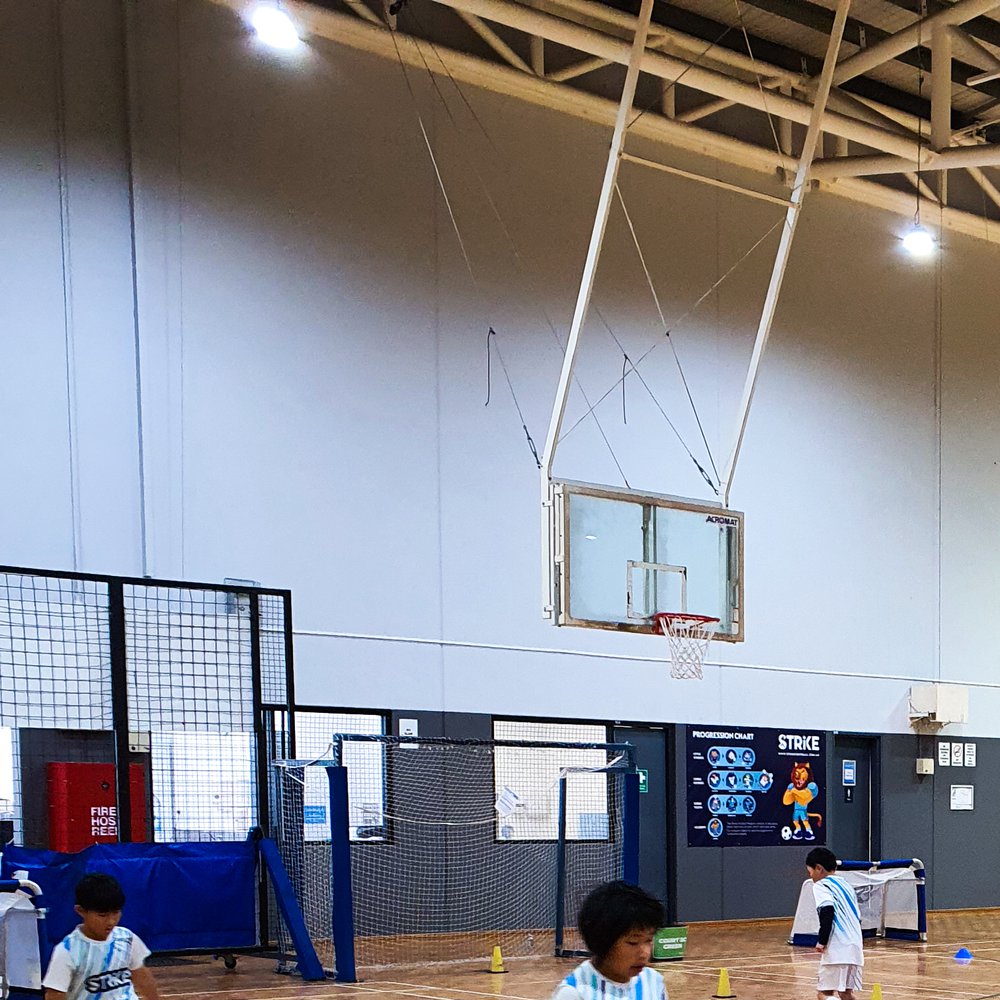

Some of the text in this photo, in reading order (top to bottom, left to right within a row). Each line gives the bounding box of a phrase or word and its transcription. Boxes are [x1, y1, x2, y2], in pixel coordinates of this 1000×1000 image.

[706, 515, 738, 526] ACROMAT
[692, 730, 754, 740] PROGRESSION CHART
[90, 806, 117, 816] FIRE
[91, 816, 117, 826] HOS
